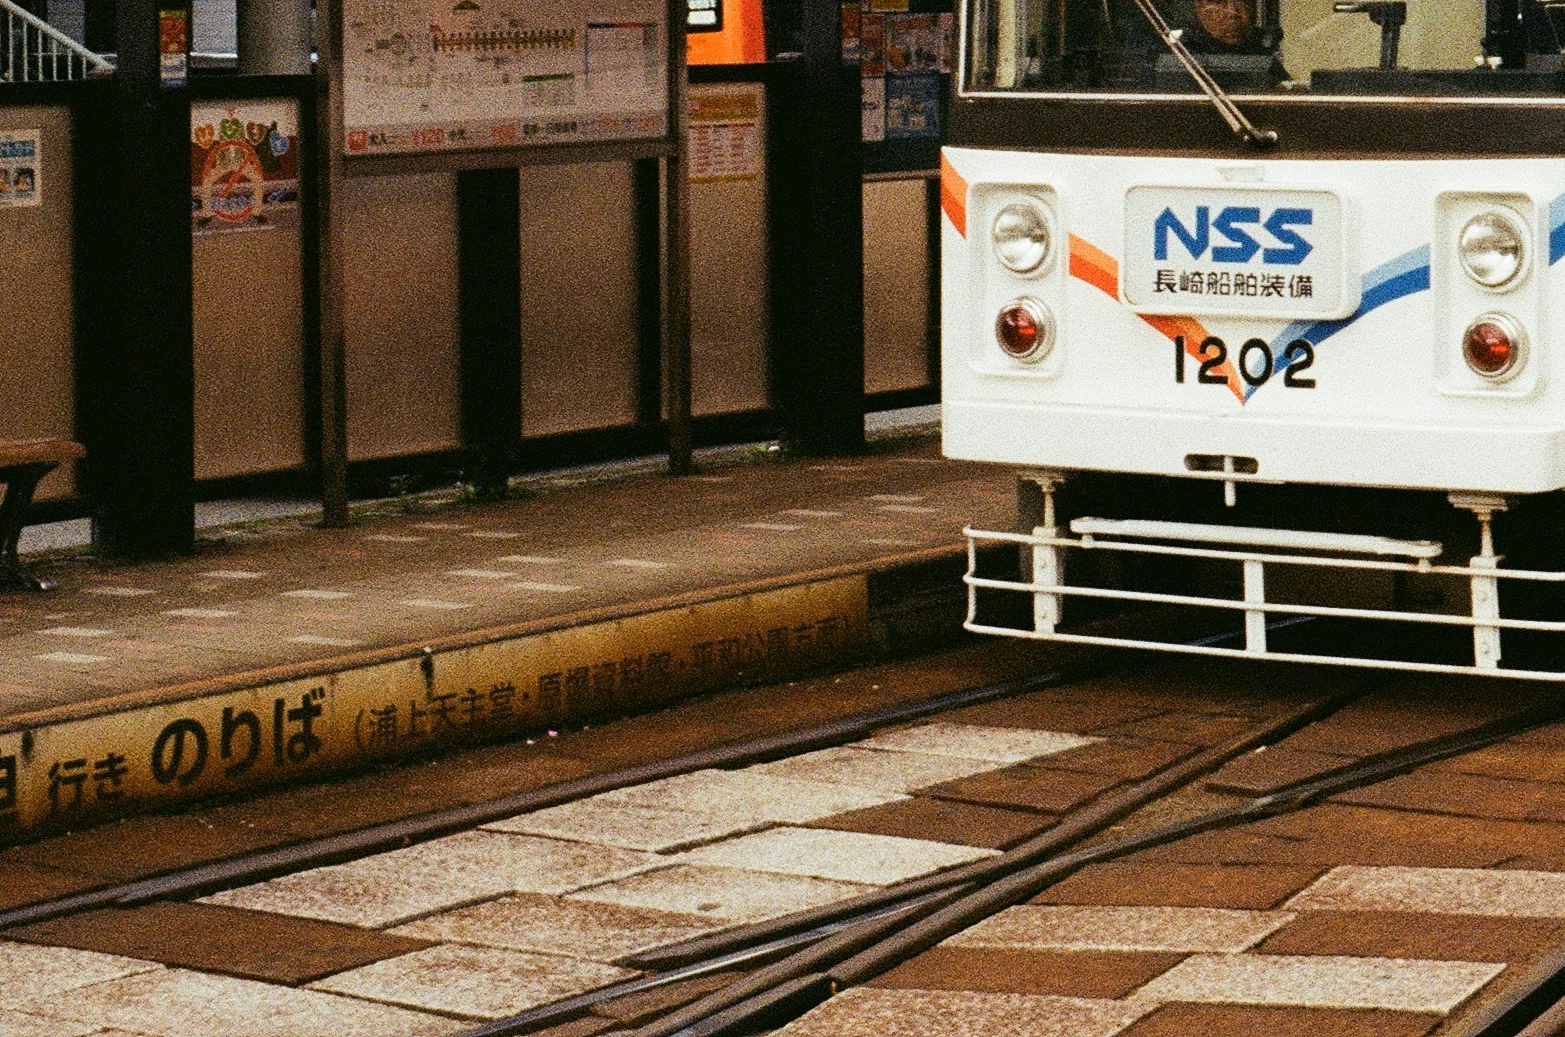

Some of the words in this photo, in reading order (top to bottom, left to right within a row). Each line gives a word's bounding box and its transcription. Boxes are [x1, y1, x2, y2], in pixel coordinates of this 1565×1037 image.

[1153, 205, 1314, 266] NSS
[1152, 269, 1315, 299] 長崎船舶装備
[1173, 334, 1317, 390] 1202
[47, 752, 129, 812] 行き
[151, 685, 326, 787] のりば
